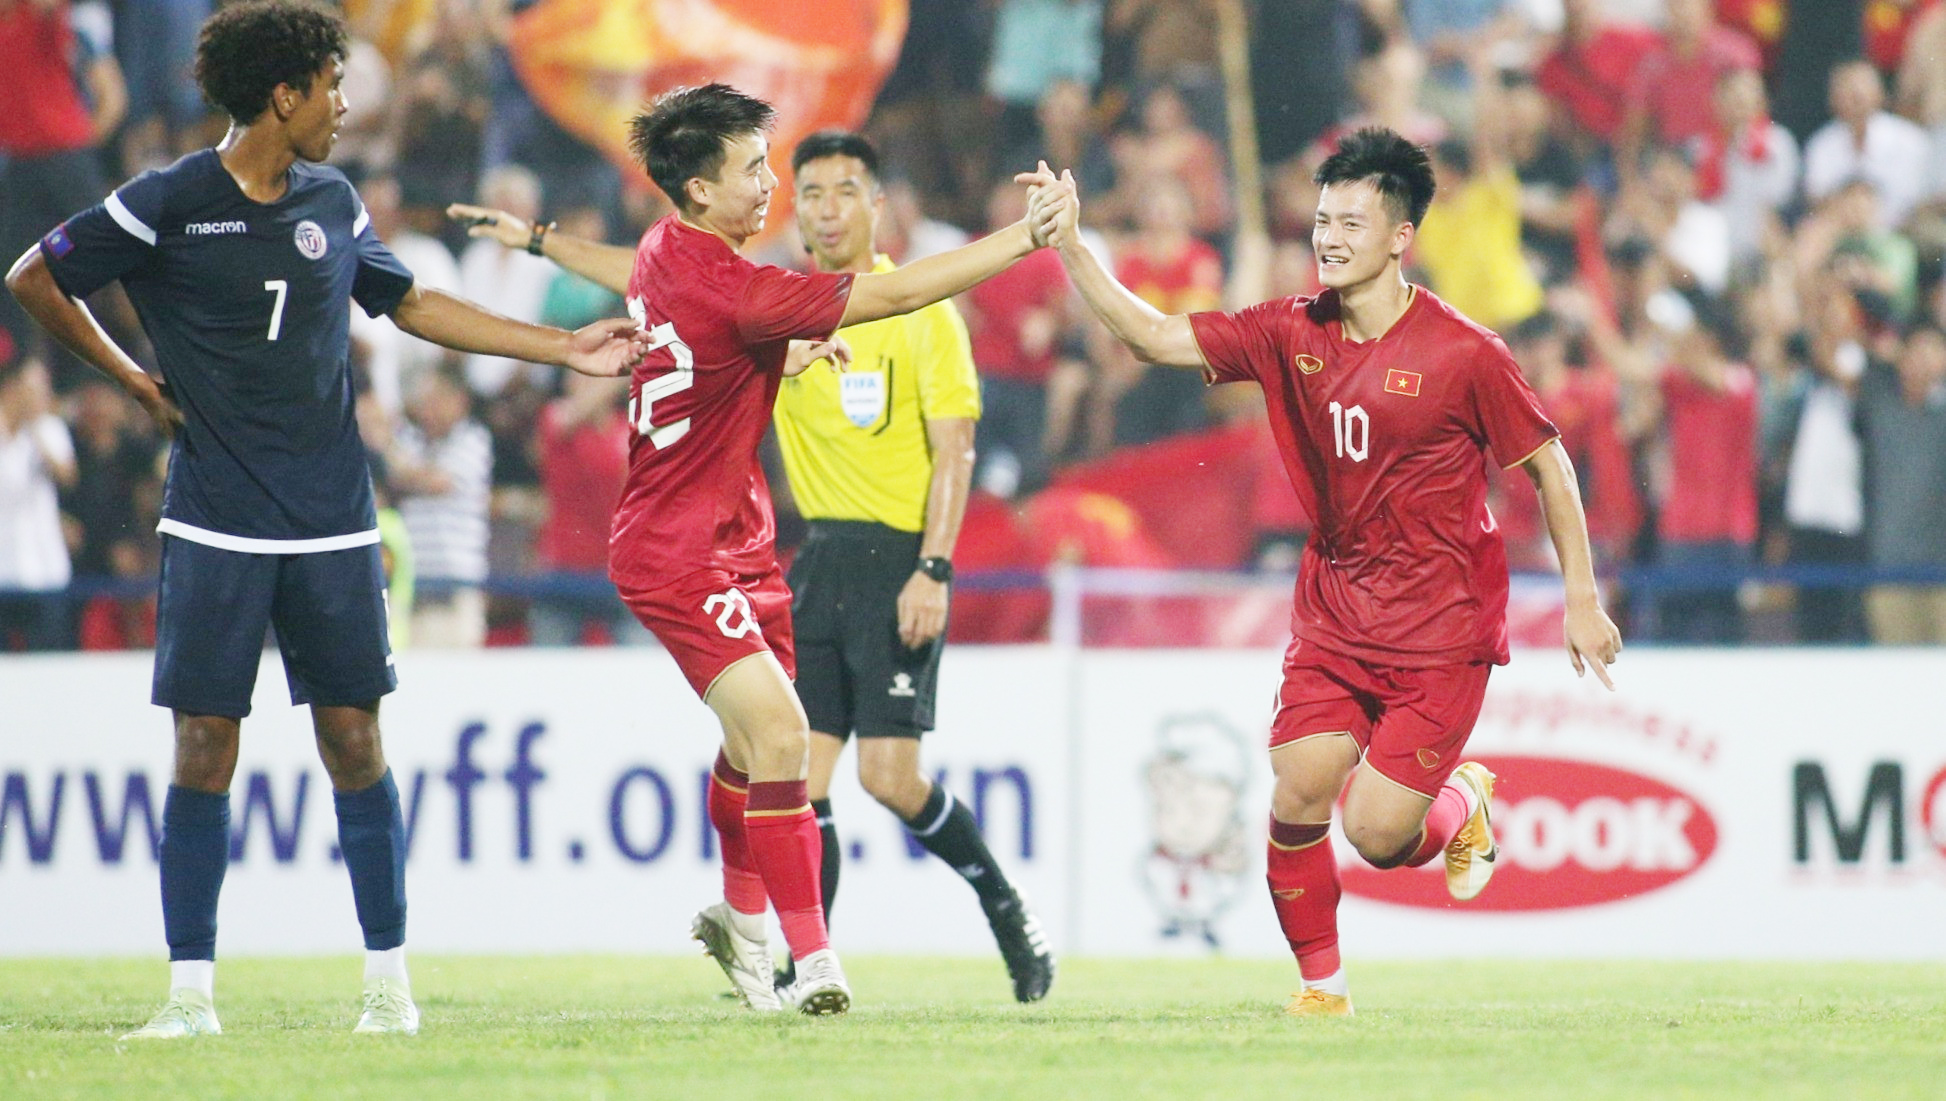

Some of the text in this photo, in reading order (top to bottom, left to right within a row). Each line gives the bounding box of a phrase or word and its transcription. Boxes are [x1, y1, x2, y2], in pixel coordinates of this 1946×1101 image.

[185, 220, 247, 235] macron
[263, 280, 289, 341] 7
[1328, 400, 1370, 463] 10
